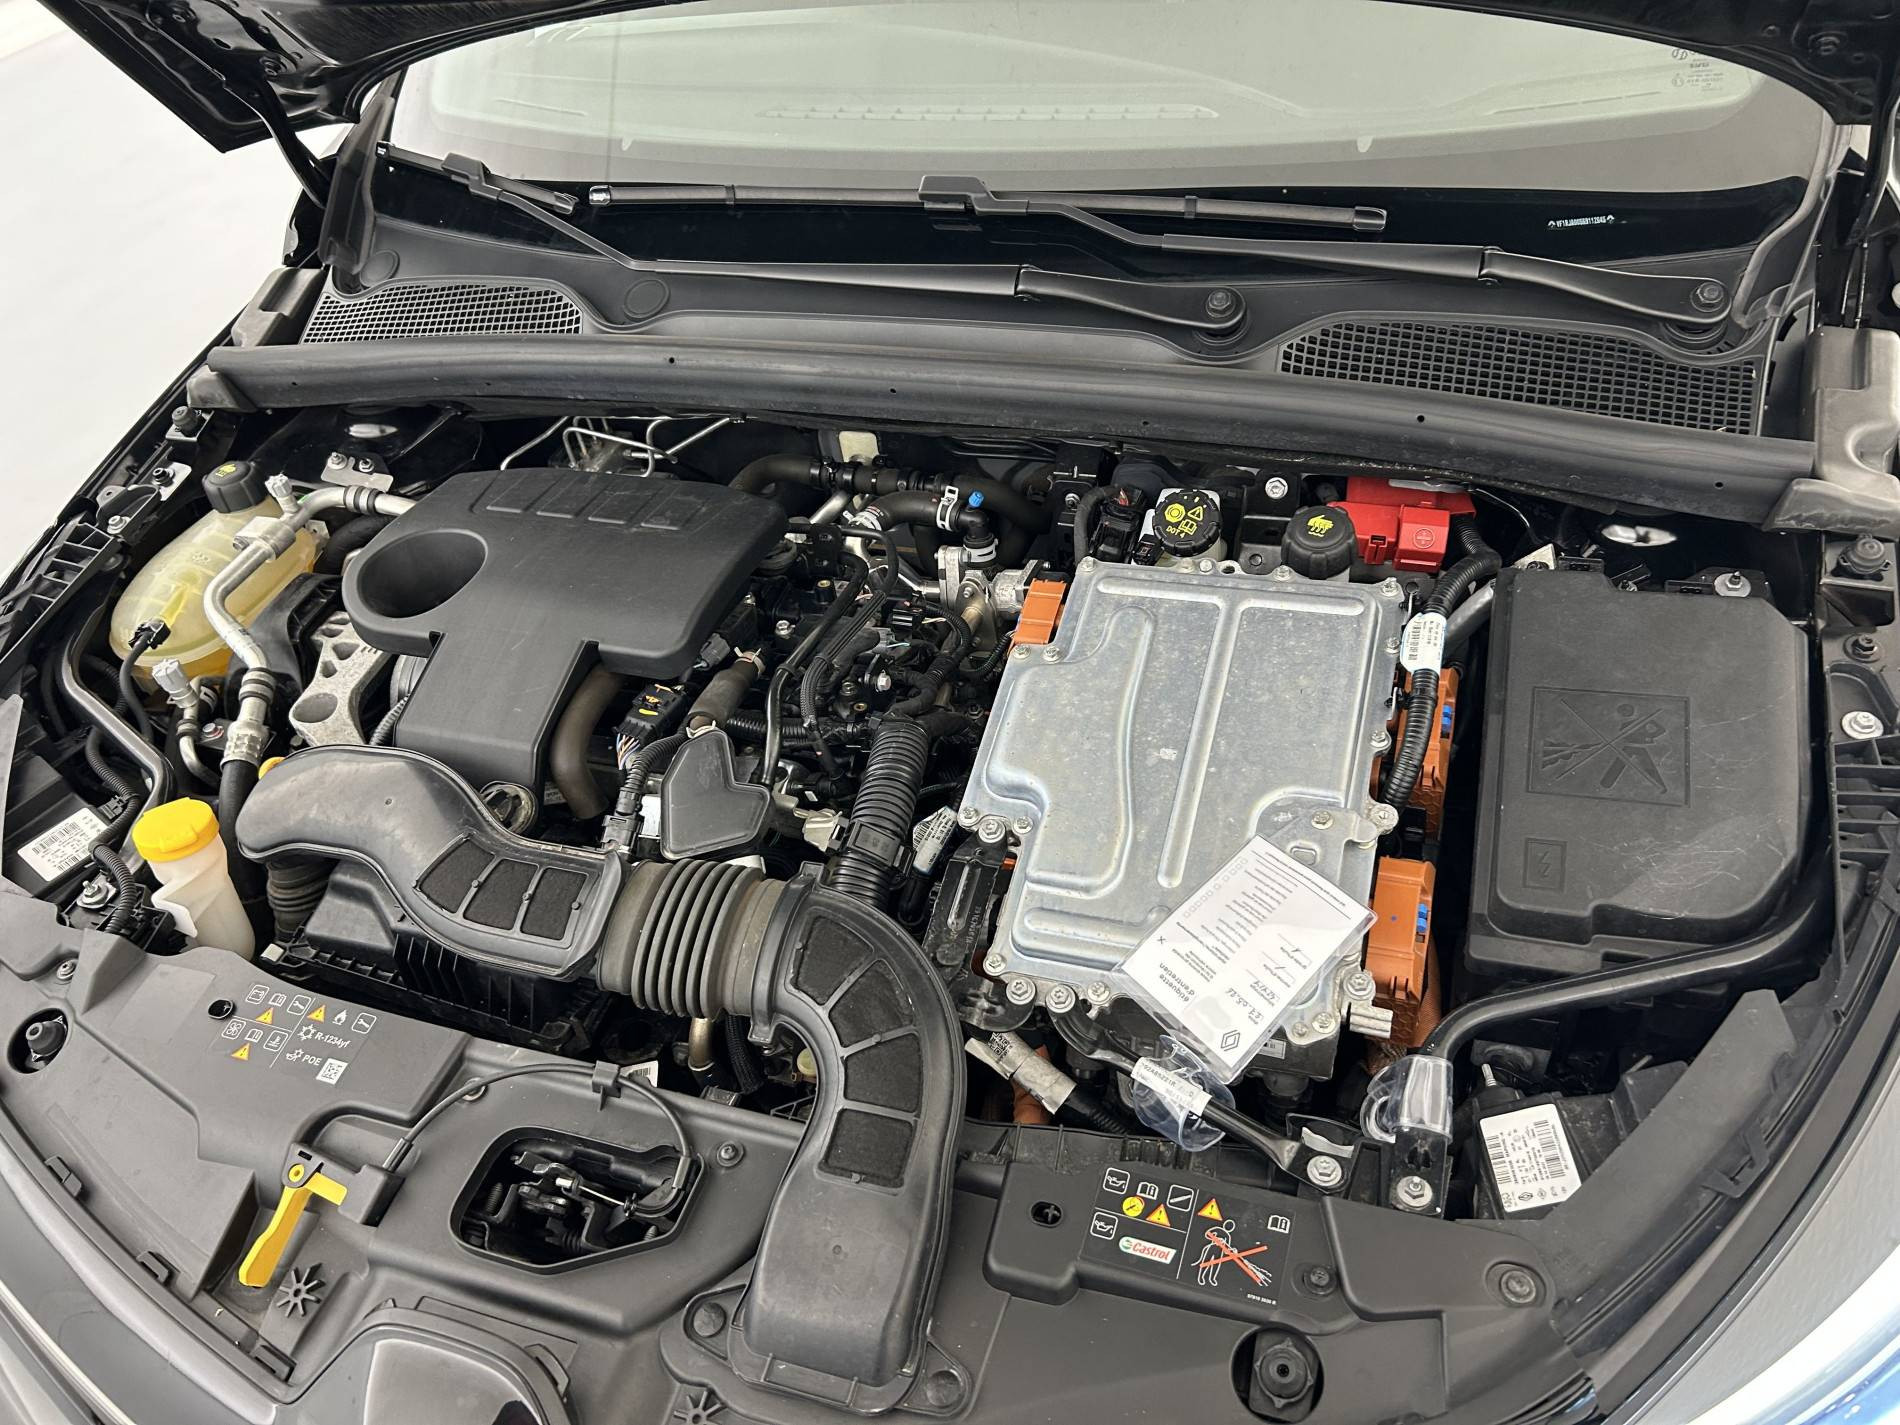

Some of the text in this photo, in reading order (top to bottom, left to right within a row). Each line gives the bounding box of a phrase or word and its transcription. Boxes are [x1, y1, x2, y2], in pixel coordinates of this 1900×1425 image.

[1166, 525, 1180, 536] DOT
[1158, 961, 1196, 997] d'entretien
[1158, 972, 1190, 1003] étiquette
[315, 1032, 351, 1048] R-1234yf
[302, 1054, 322, 1066] POE
[1132, 1242, 1170, 1261] Castrol
